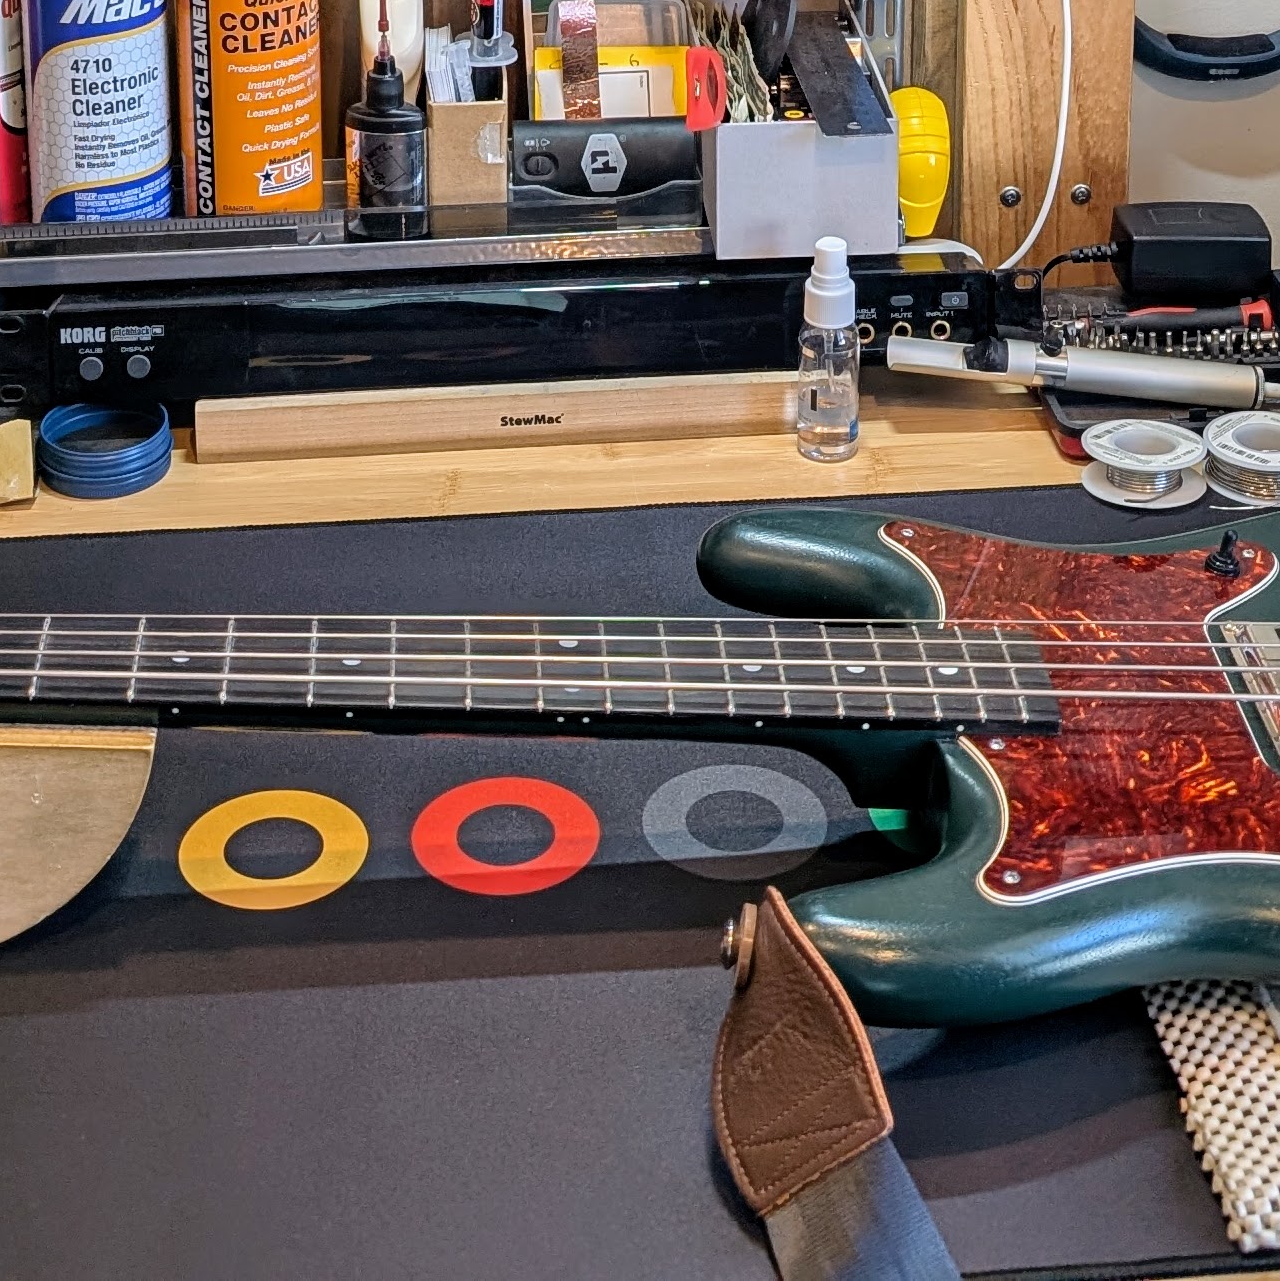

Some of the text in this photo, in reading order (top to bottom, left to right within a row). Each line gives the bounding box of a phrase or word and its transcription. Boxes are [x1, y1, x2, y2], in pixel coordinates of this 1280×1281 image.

[70, 57, 112, 74] 4710
[227, 63, 272, 73] Precision
[71, 65, 159, 96] Electronic
[247, 75, 286, 90] Instantly
[72, 93, 144, 117] Cleaner
[246, 102, 294, 119] Leaves No
[264, 113, 310, 134] Plastic Safe
[74, 134, 116, 143] Fast Drying
[74, 143, 106, 152] Instantly
[107, 137, 139, 149] Removes
[241, 135, 299, 153] Quick Drying
[74, 147, 137, 161] Harmless to Most
[196, 104, 215, 215] CONTACT
[269, 155, 290, 165] Made
[75, 161, 116, 169] No Residue
[283, 161, 310, 181] USA
[60, 326, 107, 344] KORG
[78, 345, 156, 355] CALIB DISPLAY
[500, 414, 562, 427] StewMac
